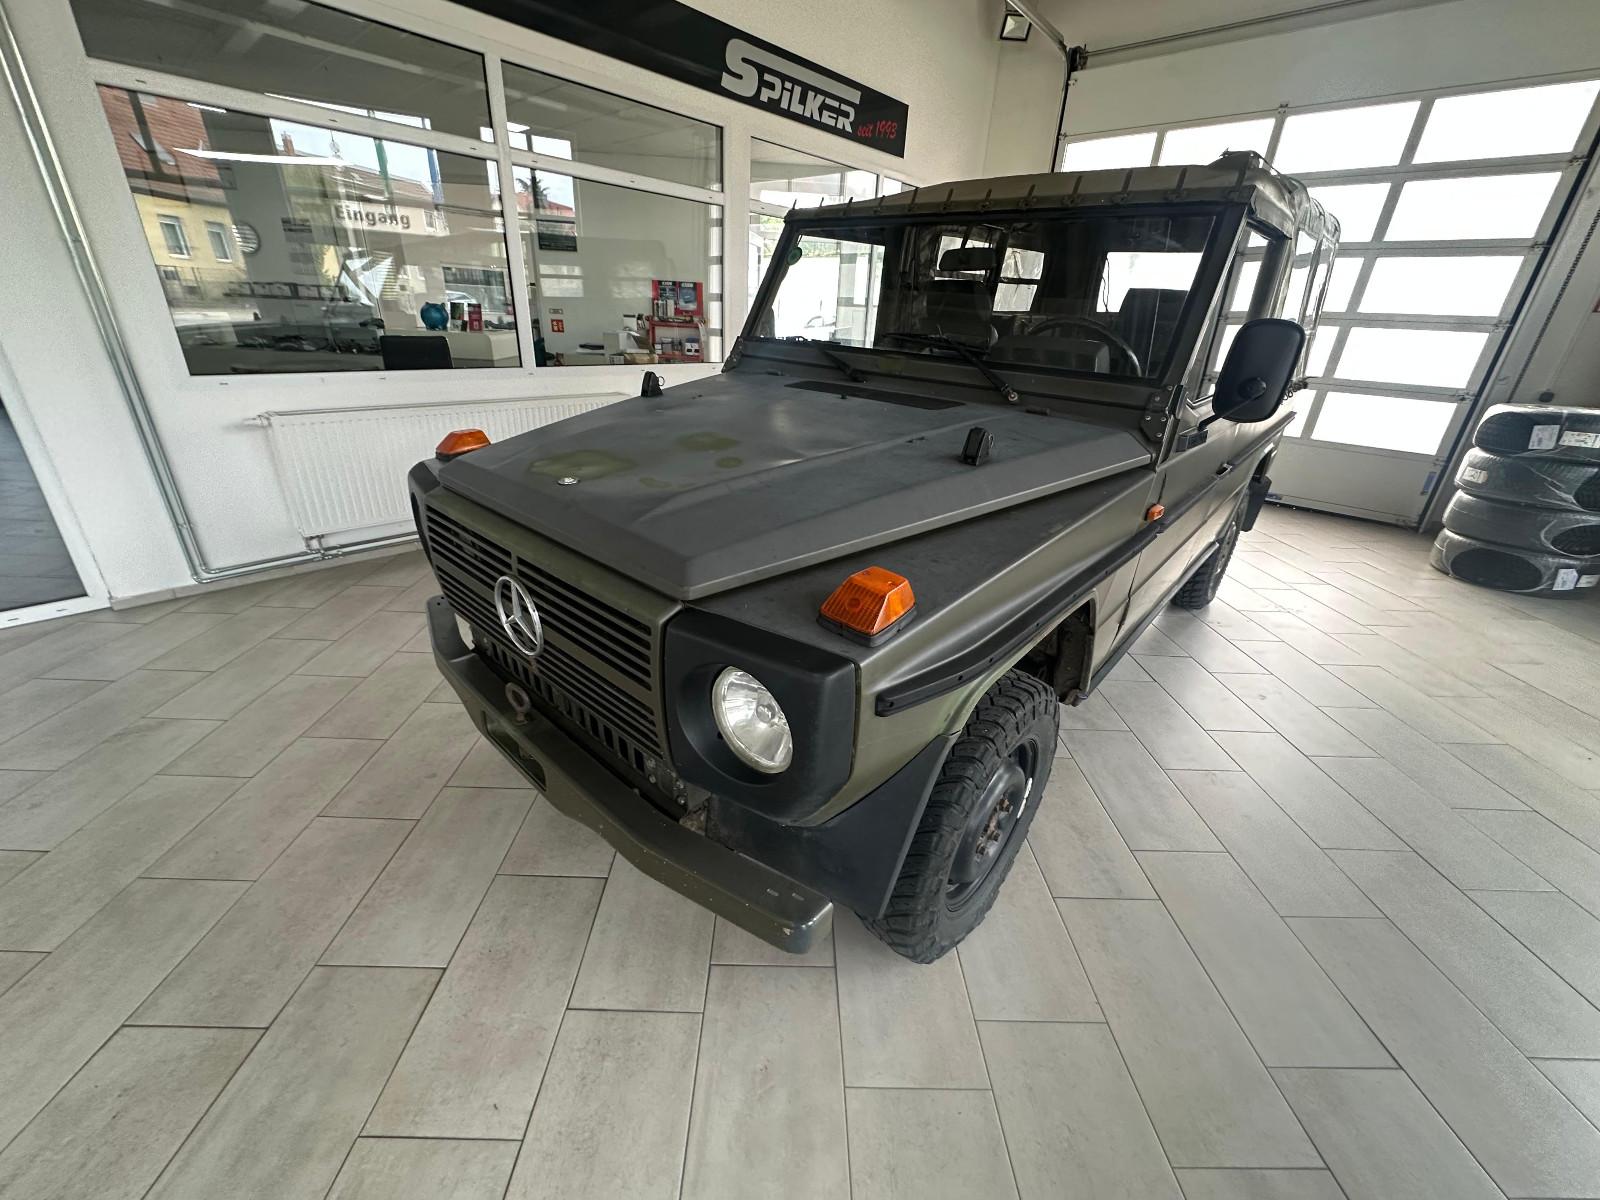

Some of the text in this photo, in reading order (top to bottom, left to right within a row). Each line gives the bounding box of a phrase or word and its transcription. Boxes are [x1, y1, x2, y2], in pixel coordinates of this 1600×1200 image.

[857, 120, 898, 139] seit 1993
[334, 204, 410, 229] Eingang
